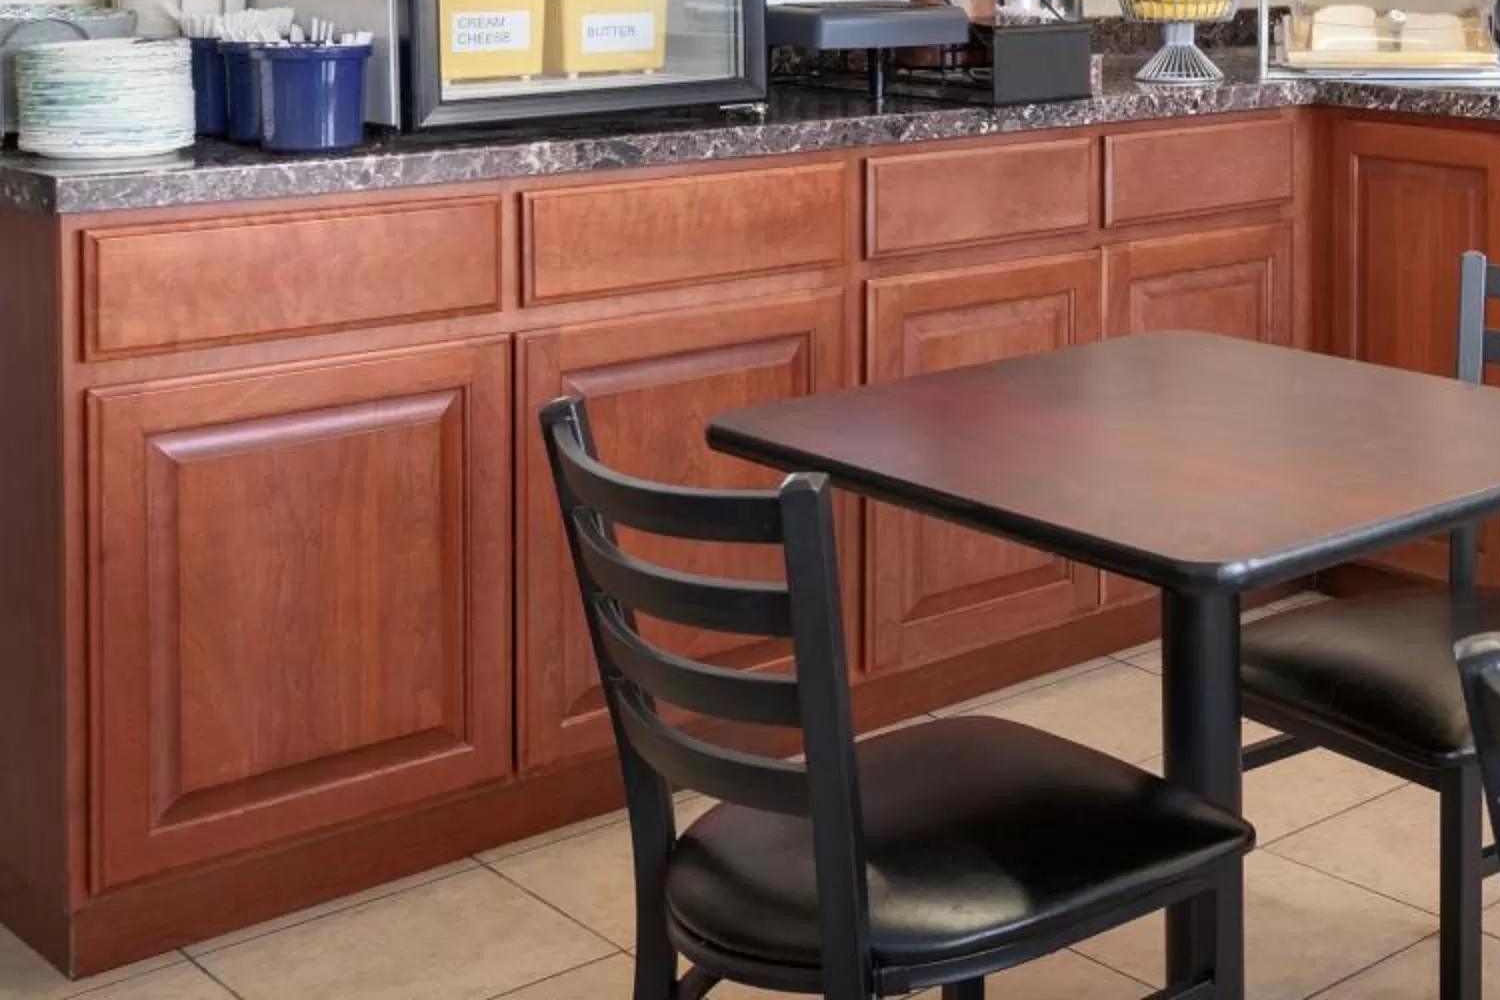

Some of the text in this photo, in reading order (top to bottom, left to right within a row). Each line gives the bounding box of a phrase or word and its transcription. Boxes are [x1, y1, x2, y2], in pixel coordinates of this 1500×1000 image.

[457, 16, 506, 29] CREAM
[457, 31, 512, 45] CHEESE
[587, 25, 636, 38] BUTTER
